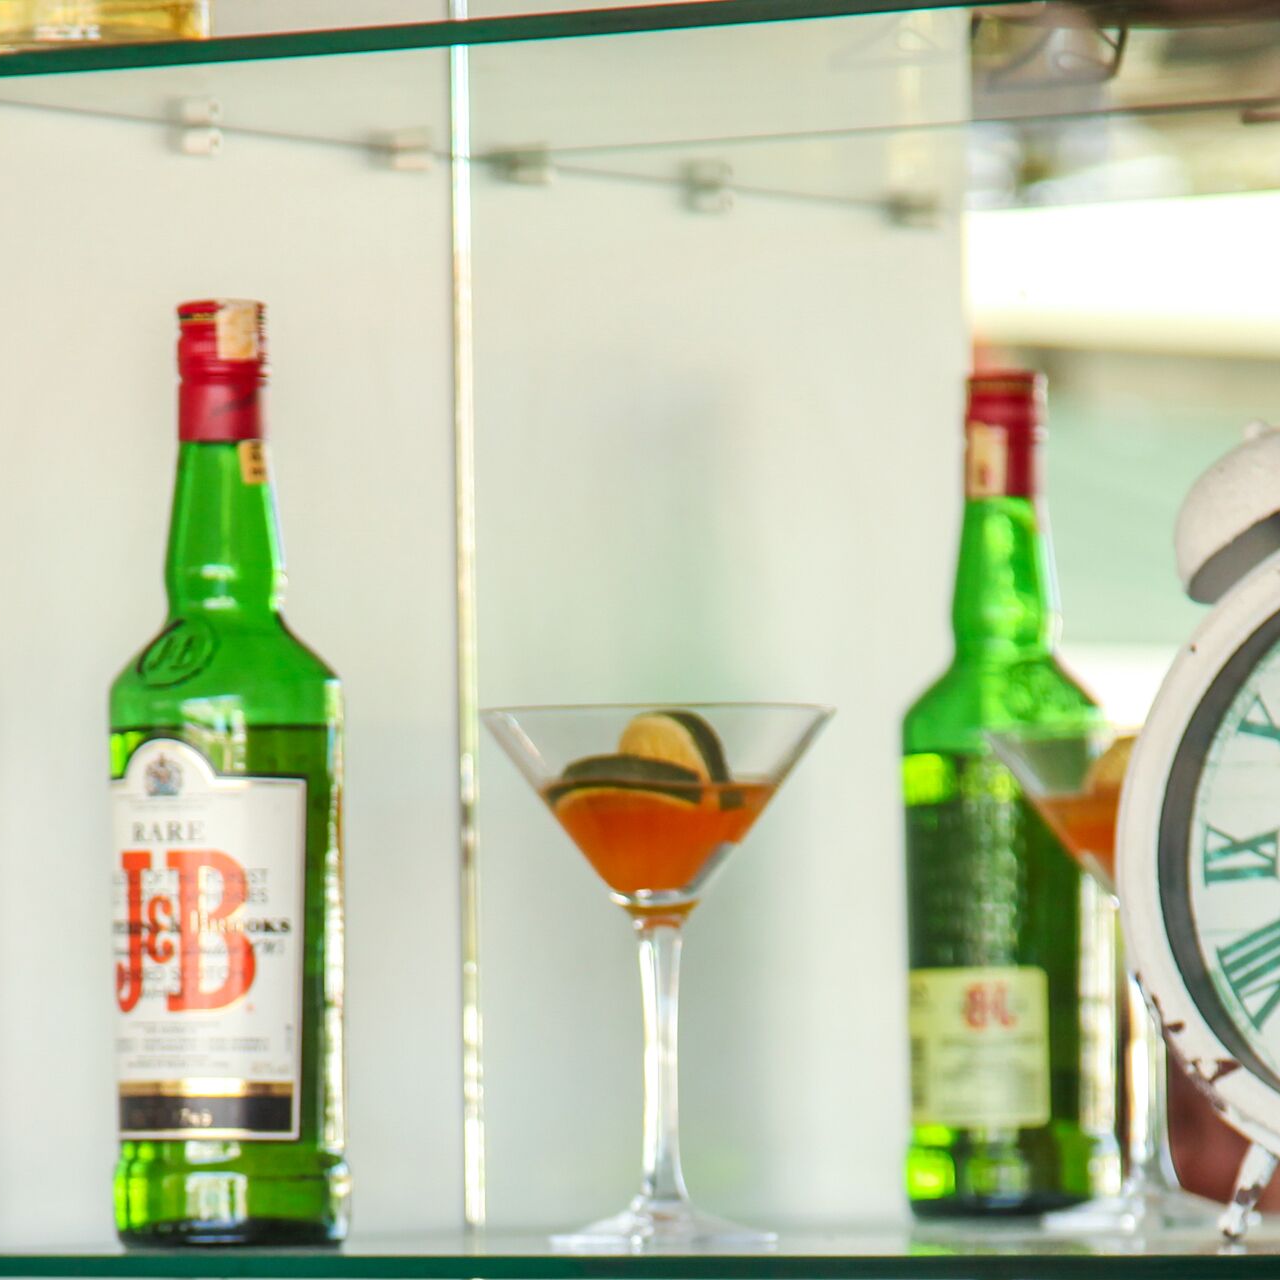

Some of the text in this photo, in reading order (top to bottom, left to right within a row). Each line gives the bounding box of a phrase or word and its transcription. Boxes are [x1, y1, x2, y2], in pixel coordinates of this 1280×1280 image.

[132, 821, 206, 843] RARE
[1203, 822, 1280, 888] IX
[116, 850, 258, 1014] J&B
